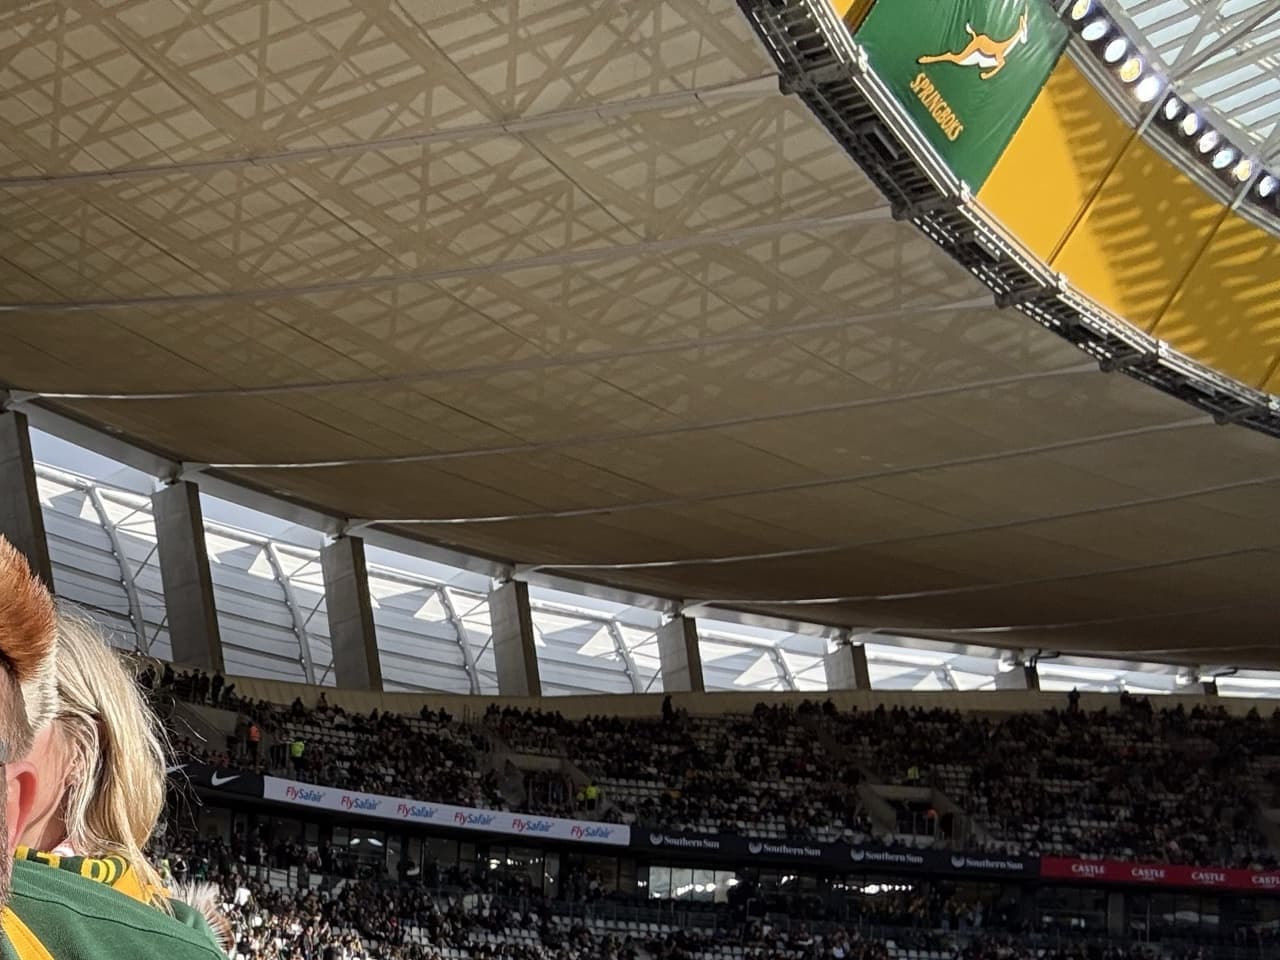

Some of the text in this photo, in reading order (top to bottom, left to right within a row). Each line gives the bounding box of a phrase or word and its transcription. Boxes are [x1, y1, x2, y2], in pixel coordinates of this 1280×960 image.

[910, 73, 963, 141] SPRINGBOKS
[285, 786, 322, 802] FlySafair
[340, 795, 377, 810] FlySafair
[396, 803, 435, 818] FlySafair
[454, 811, 493, 825] FlySafair
[511, 818, 552, 833] FlySafair
[570, 825, 612, 839] FlySafair
[664, 836, 720, 849] Southern Sun
[763, 843, 821, 856] Southern Sun
[865, 851, 923, 864] Southern Sun
[966, 857, 1023, 870] Southern Sun
[1071, 863, 1105, 875] CASTLE
[1131, 867, 1165, 878] CASTLE
[1191, 871, 1226, 882] CASTLE
